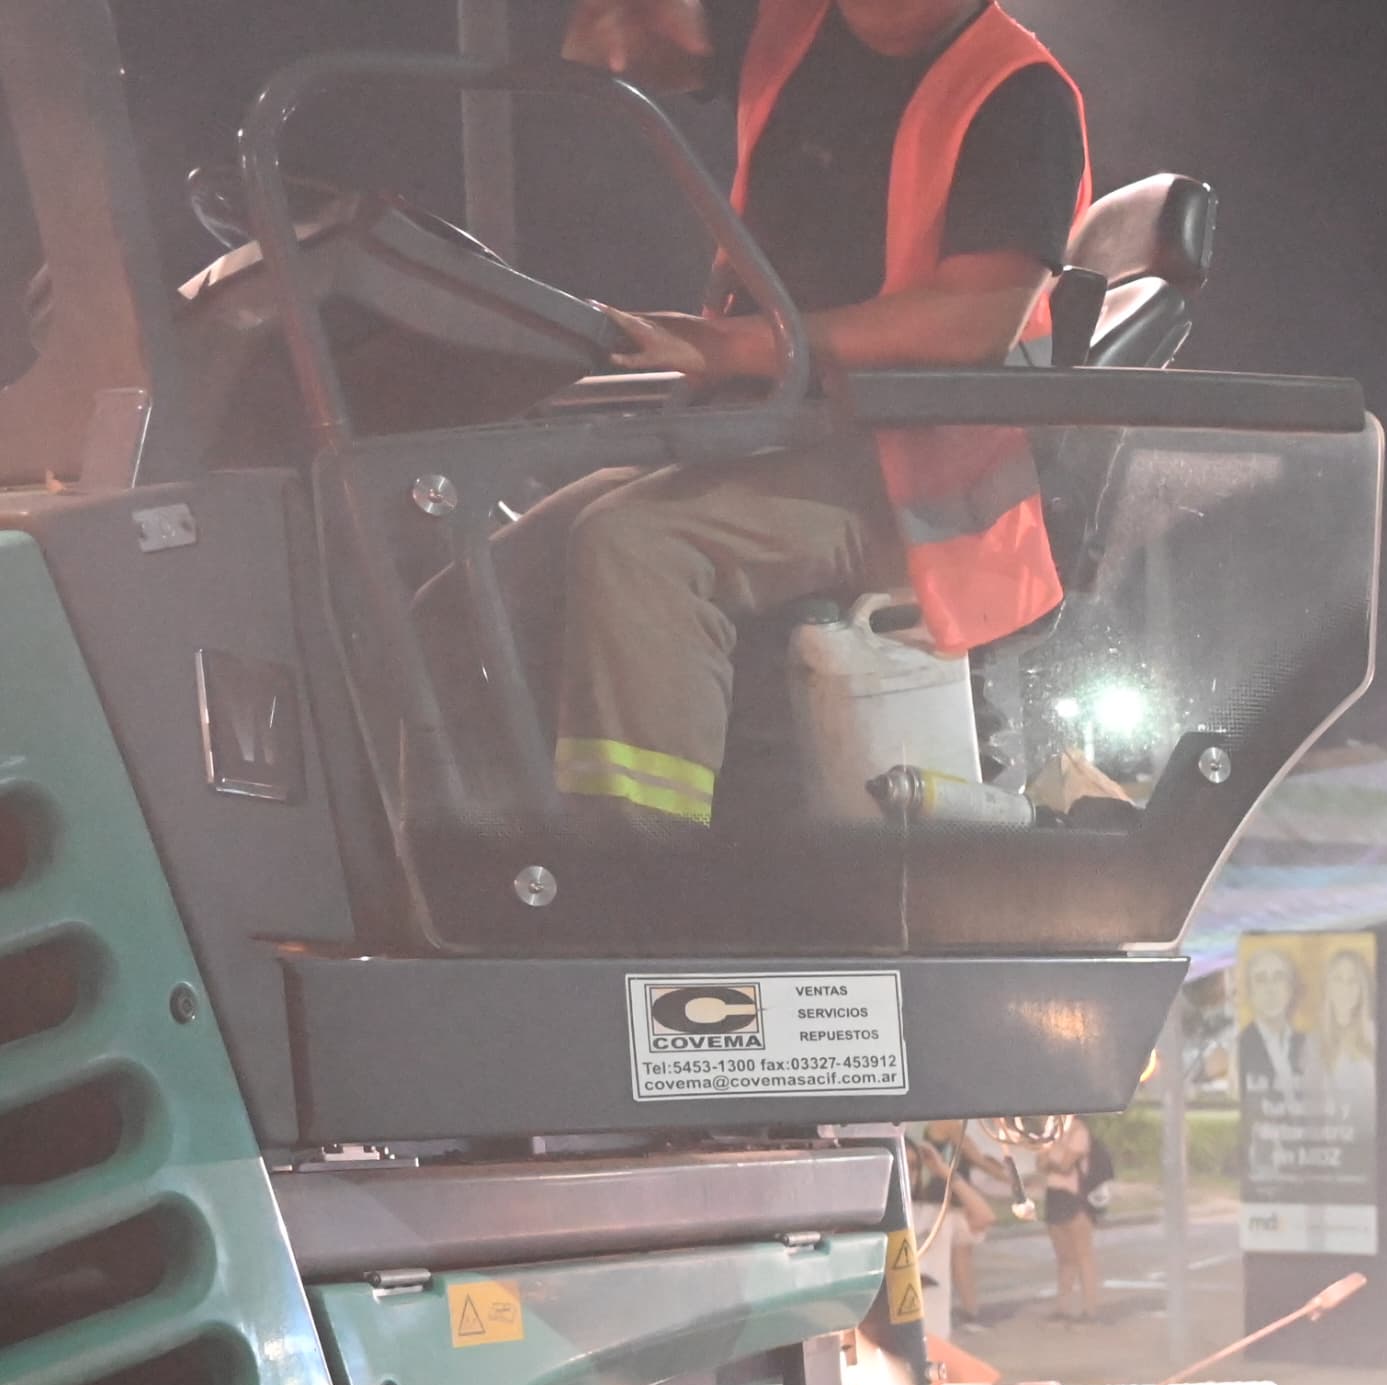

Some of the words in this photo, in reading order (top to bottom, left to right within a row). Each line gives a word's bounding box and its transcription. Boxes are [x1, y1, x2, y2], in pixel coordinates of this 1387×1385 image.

[795, 985, 848, 997] VENTAS
[797, 1007, 869, 1019] SERVICIOS
[652, 1034, 763, 1050] COVEMA
[799, 1029, 880, 1042] REPUESTOS
[642, 1059, 756, 1075] Tel:5453-1300
[644, 1071, 898, 1091] covema@covemasacif.com.ar
